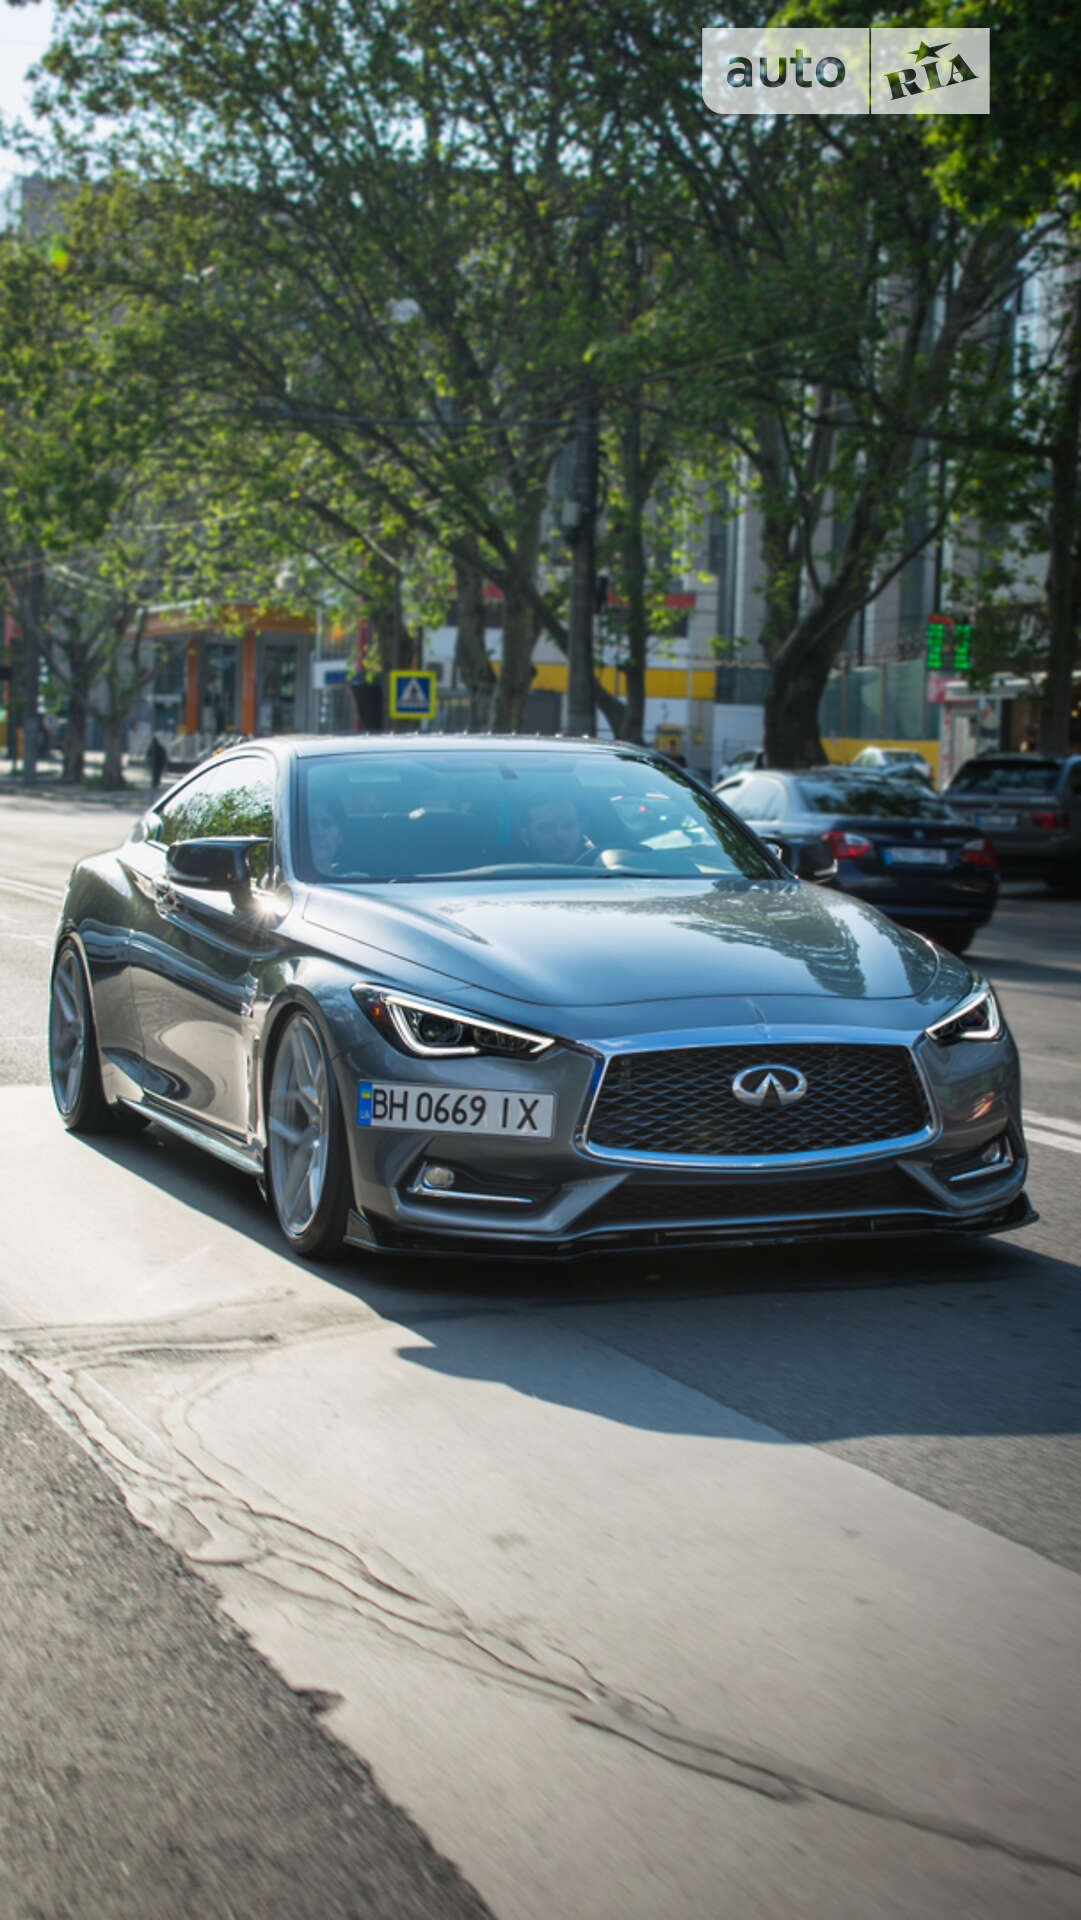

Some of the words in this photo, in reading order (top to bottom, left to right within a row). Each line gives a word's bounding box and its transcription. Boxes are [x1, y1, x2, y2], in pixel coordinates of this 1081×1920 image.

[372, 1089, 408, 1121] BH
[416, 1092, 487, 1126] 0669
[501, 1097, 539, 1130] IX
